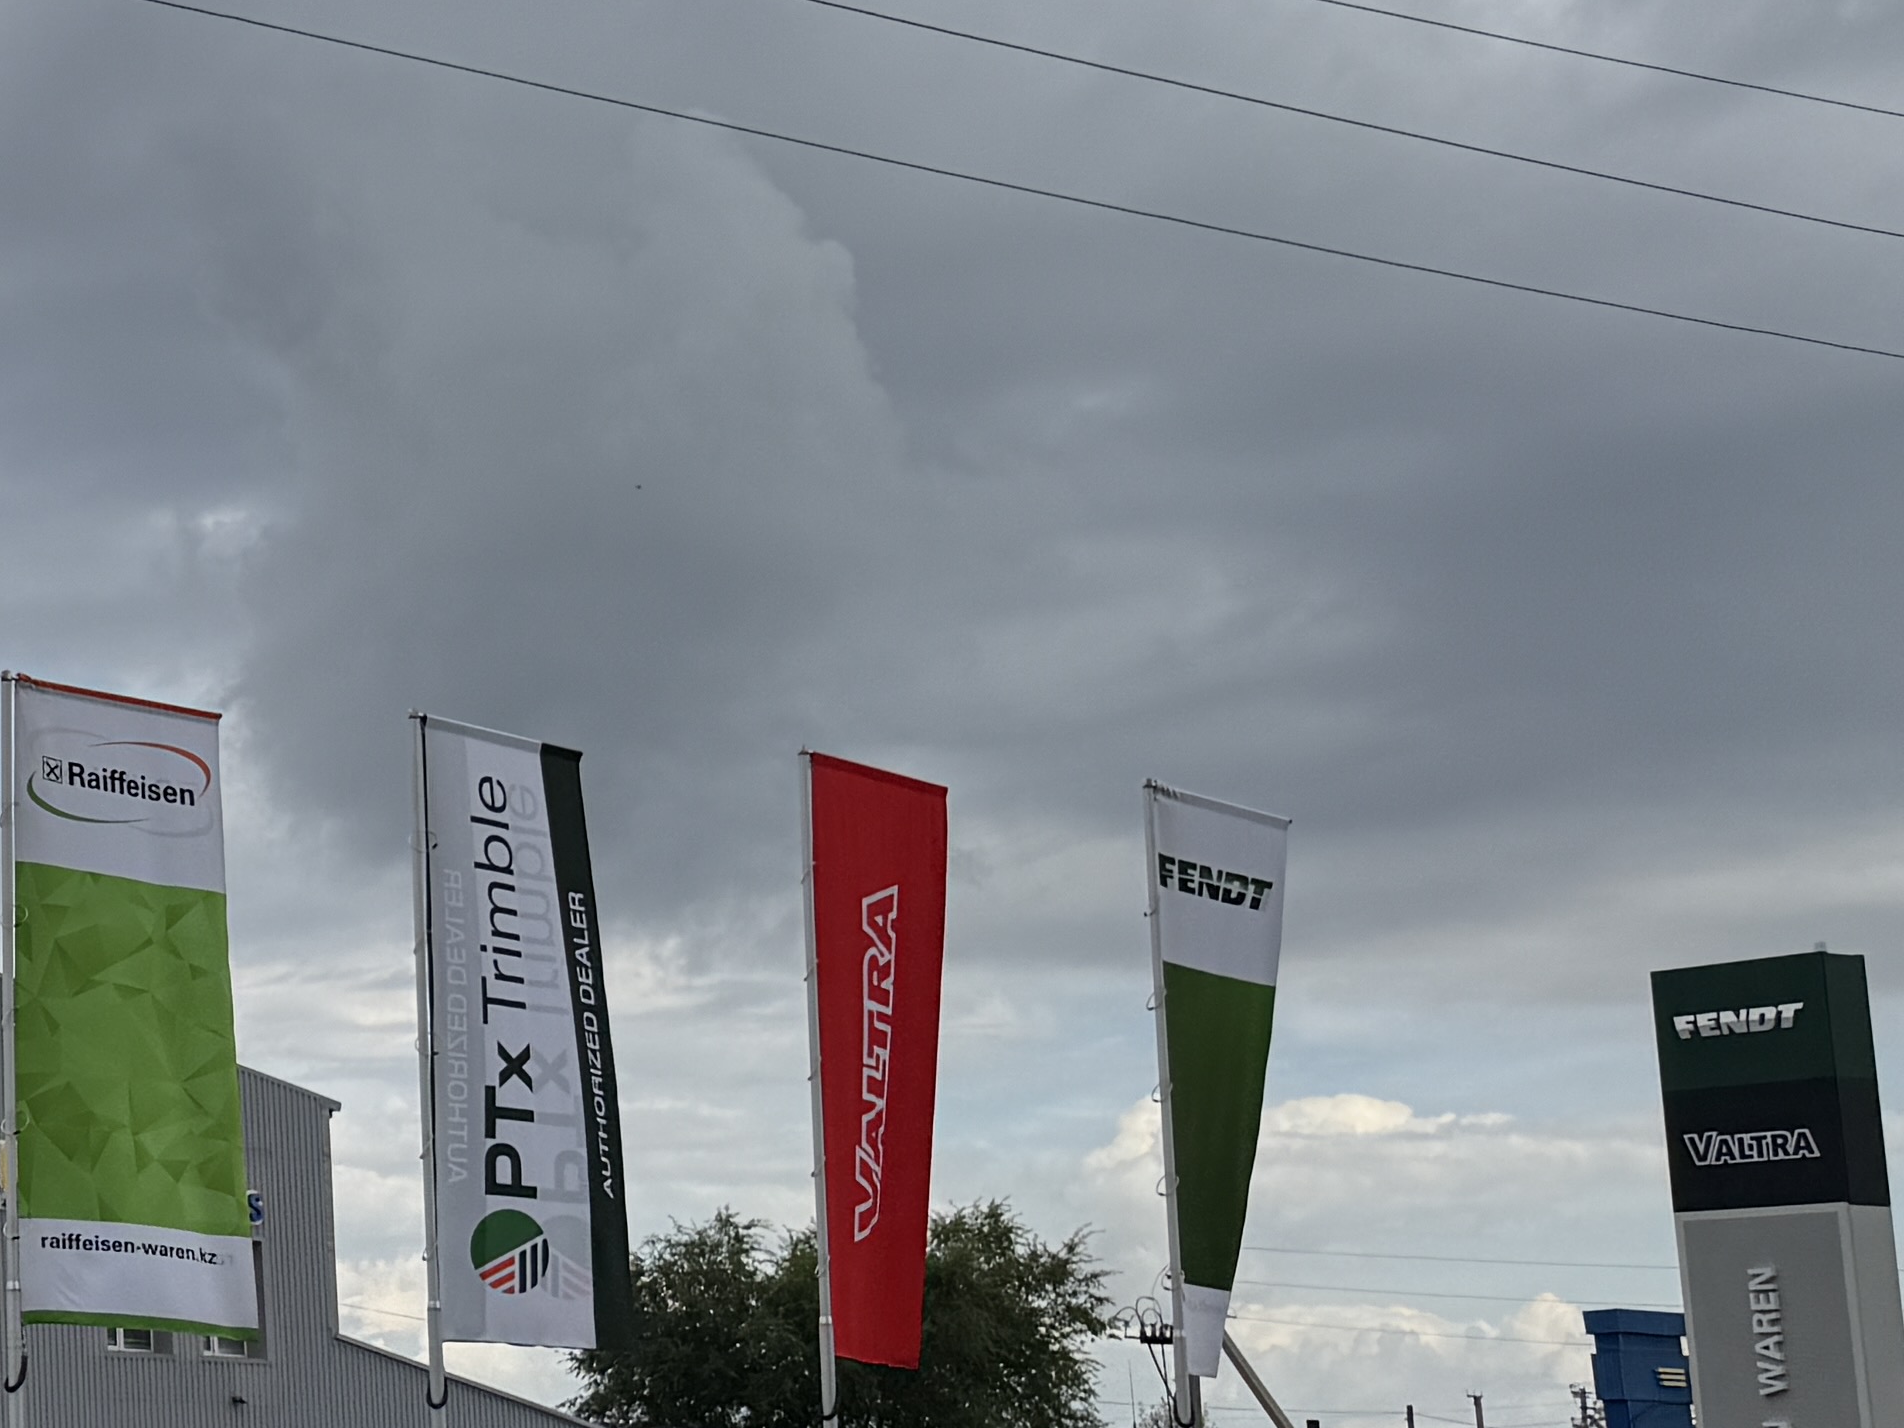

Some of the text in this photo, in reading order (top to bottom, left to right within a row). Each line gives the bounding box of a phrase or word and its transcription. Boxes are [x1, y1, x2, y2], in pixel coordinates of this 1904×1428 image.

[67, 761, 195, 807] Raiffeisen
[1158, 853, 1273, 911] FENDT
[470, 776, 537, 1199] PTx Trimble
[568, 891, 614, 1199] AUTHORIZED DEALER
[1673, 1002, 1804, 1039] FENDT
[853, 884, 899, 1242] VALTRA
[1683, 1128, 1821, 1168] VALTRA
[41, 1233, 217, 1265] raiffeisen-waren.kz
[1747, 1264, 1793, 1398] WAREN
